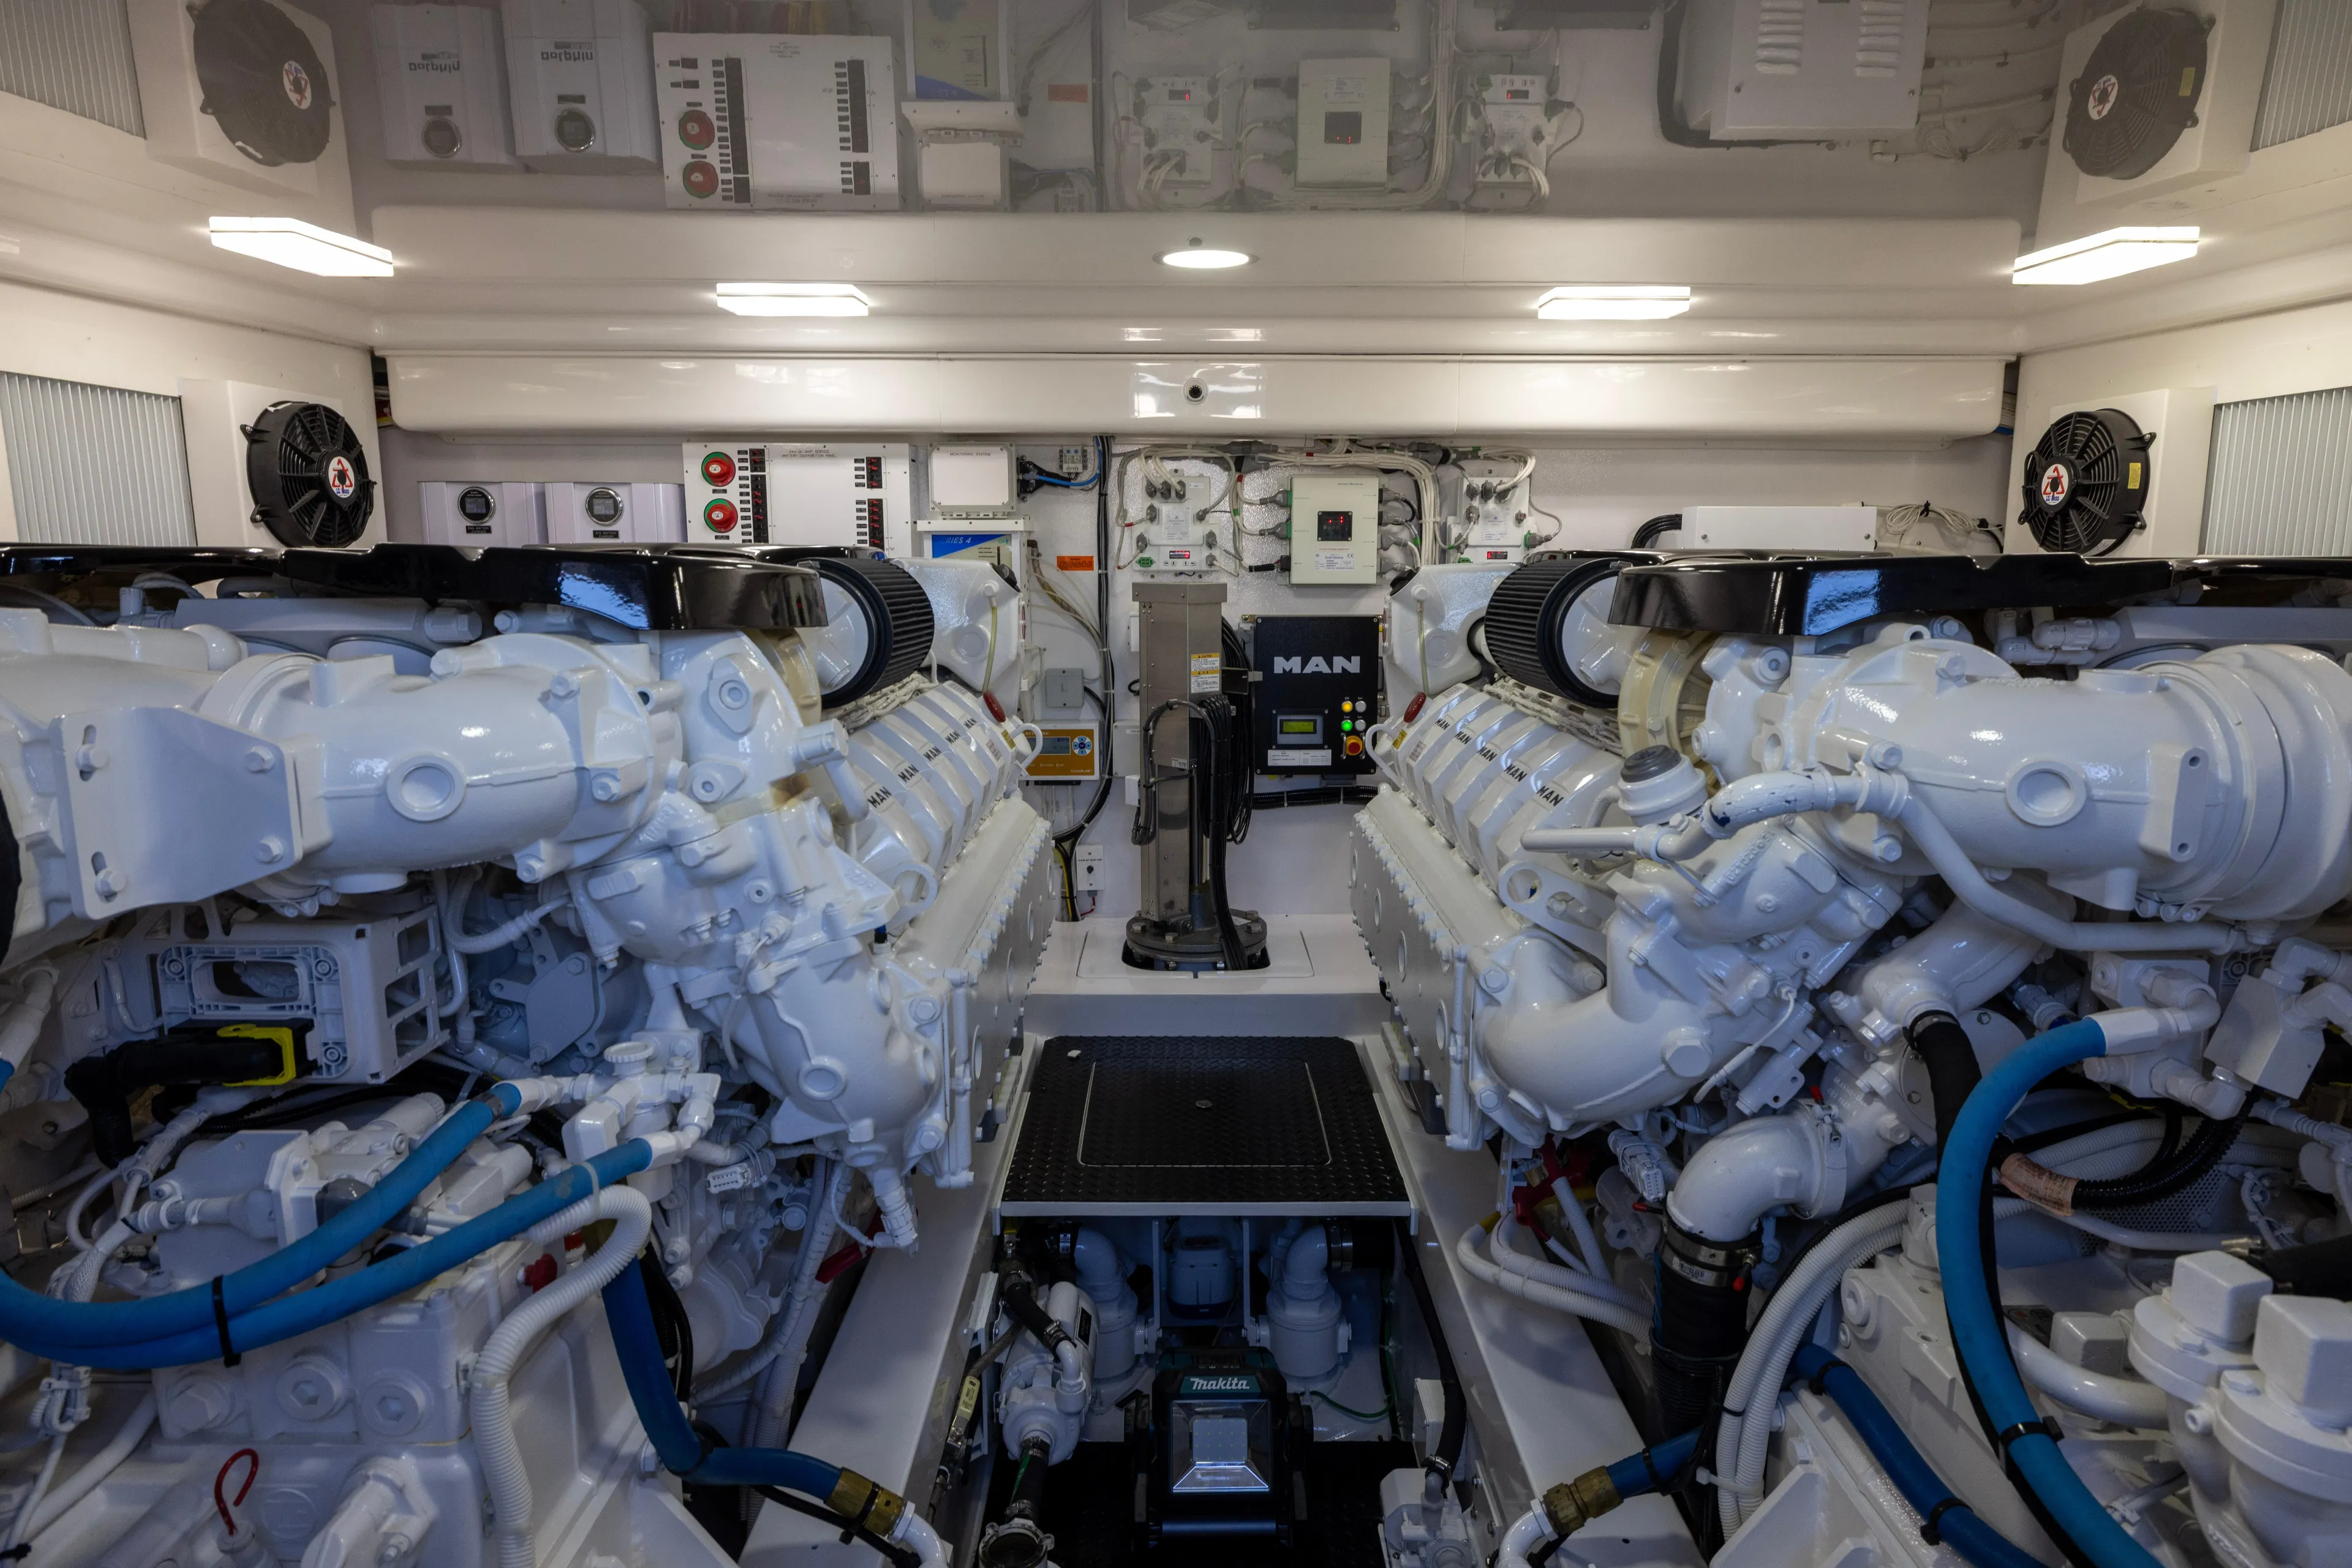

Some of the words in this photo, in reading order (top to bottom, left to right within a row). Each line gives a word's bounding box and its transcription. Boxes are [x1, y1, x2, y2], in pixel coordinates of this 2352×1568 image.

[1273, 656, 1360, 674] MAN
[963, 717, 978, 729] MAN
[1435, 717, 1450, 730] MAN
[945, 730, 961, 744] MAN
[1455, 731, 1472, 745] MAN
[923, 746, 942, 762] MAN
[1477, 746, 1498, 762] MAN
[898, 764, 919, 783] MAN
[1504, 764, 1527, 783] MAN
[867, 786, 892, 809] MAN
[1536, 785, 1564, 807] MAN
